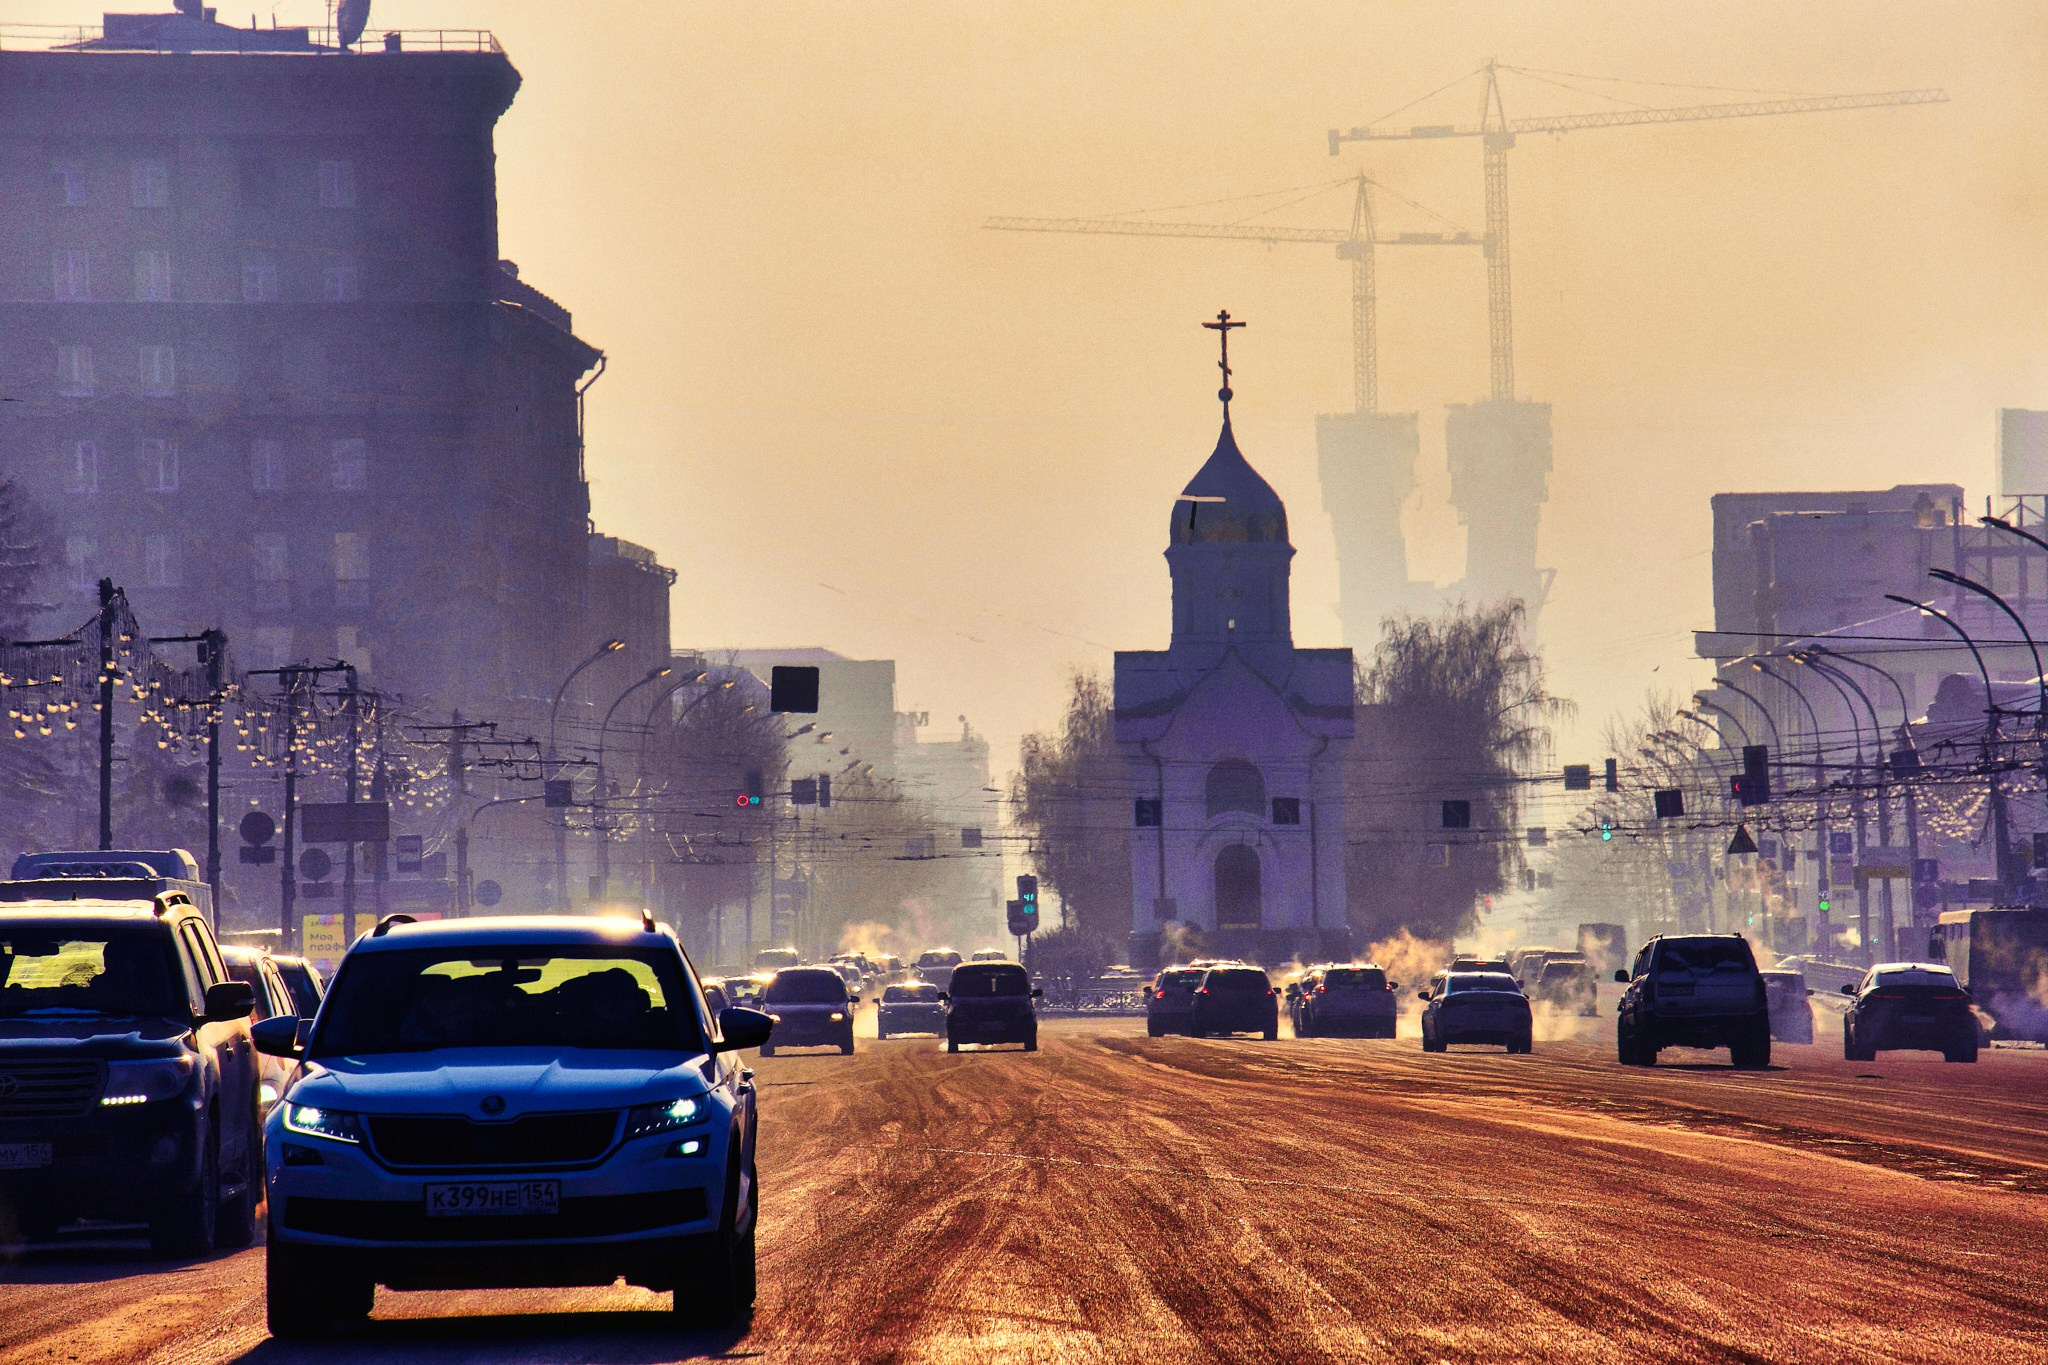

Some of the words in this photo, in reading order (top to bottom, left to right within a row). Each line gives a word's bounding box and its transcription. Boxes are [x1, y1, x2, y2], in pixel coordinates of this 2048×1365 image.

[310, 933, 333, 941] Моя
[432, 1186, 518, 1208] К399НЕ
[522, 1183, 554, 1200] 154
